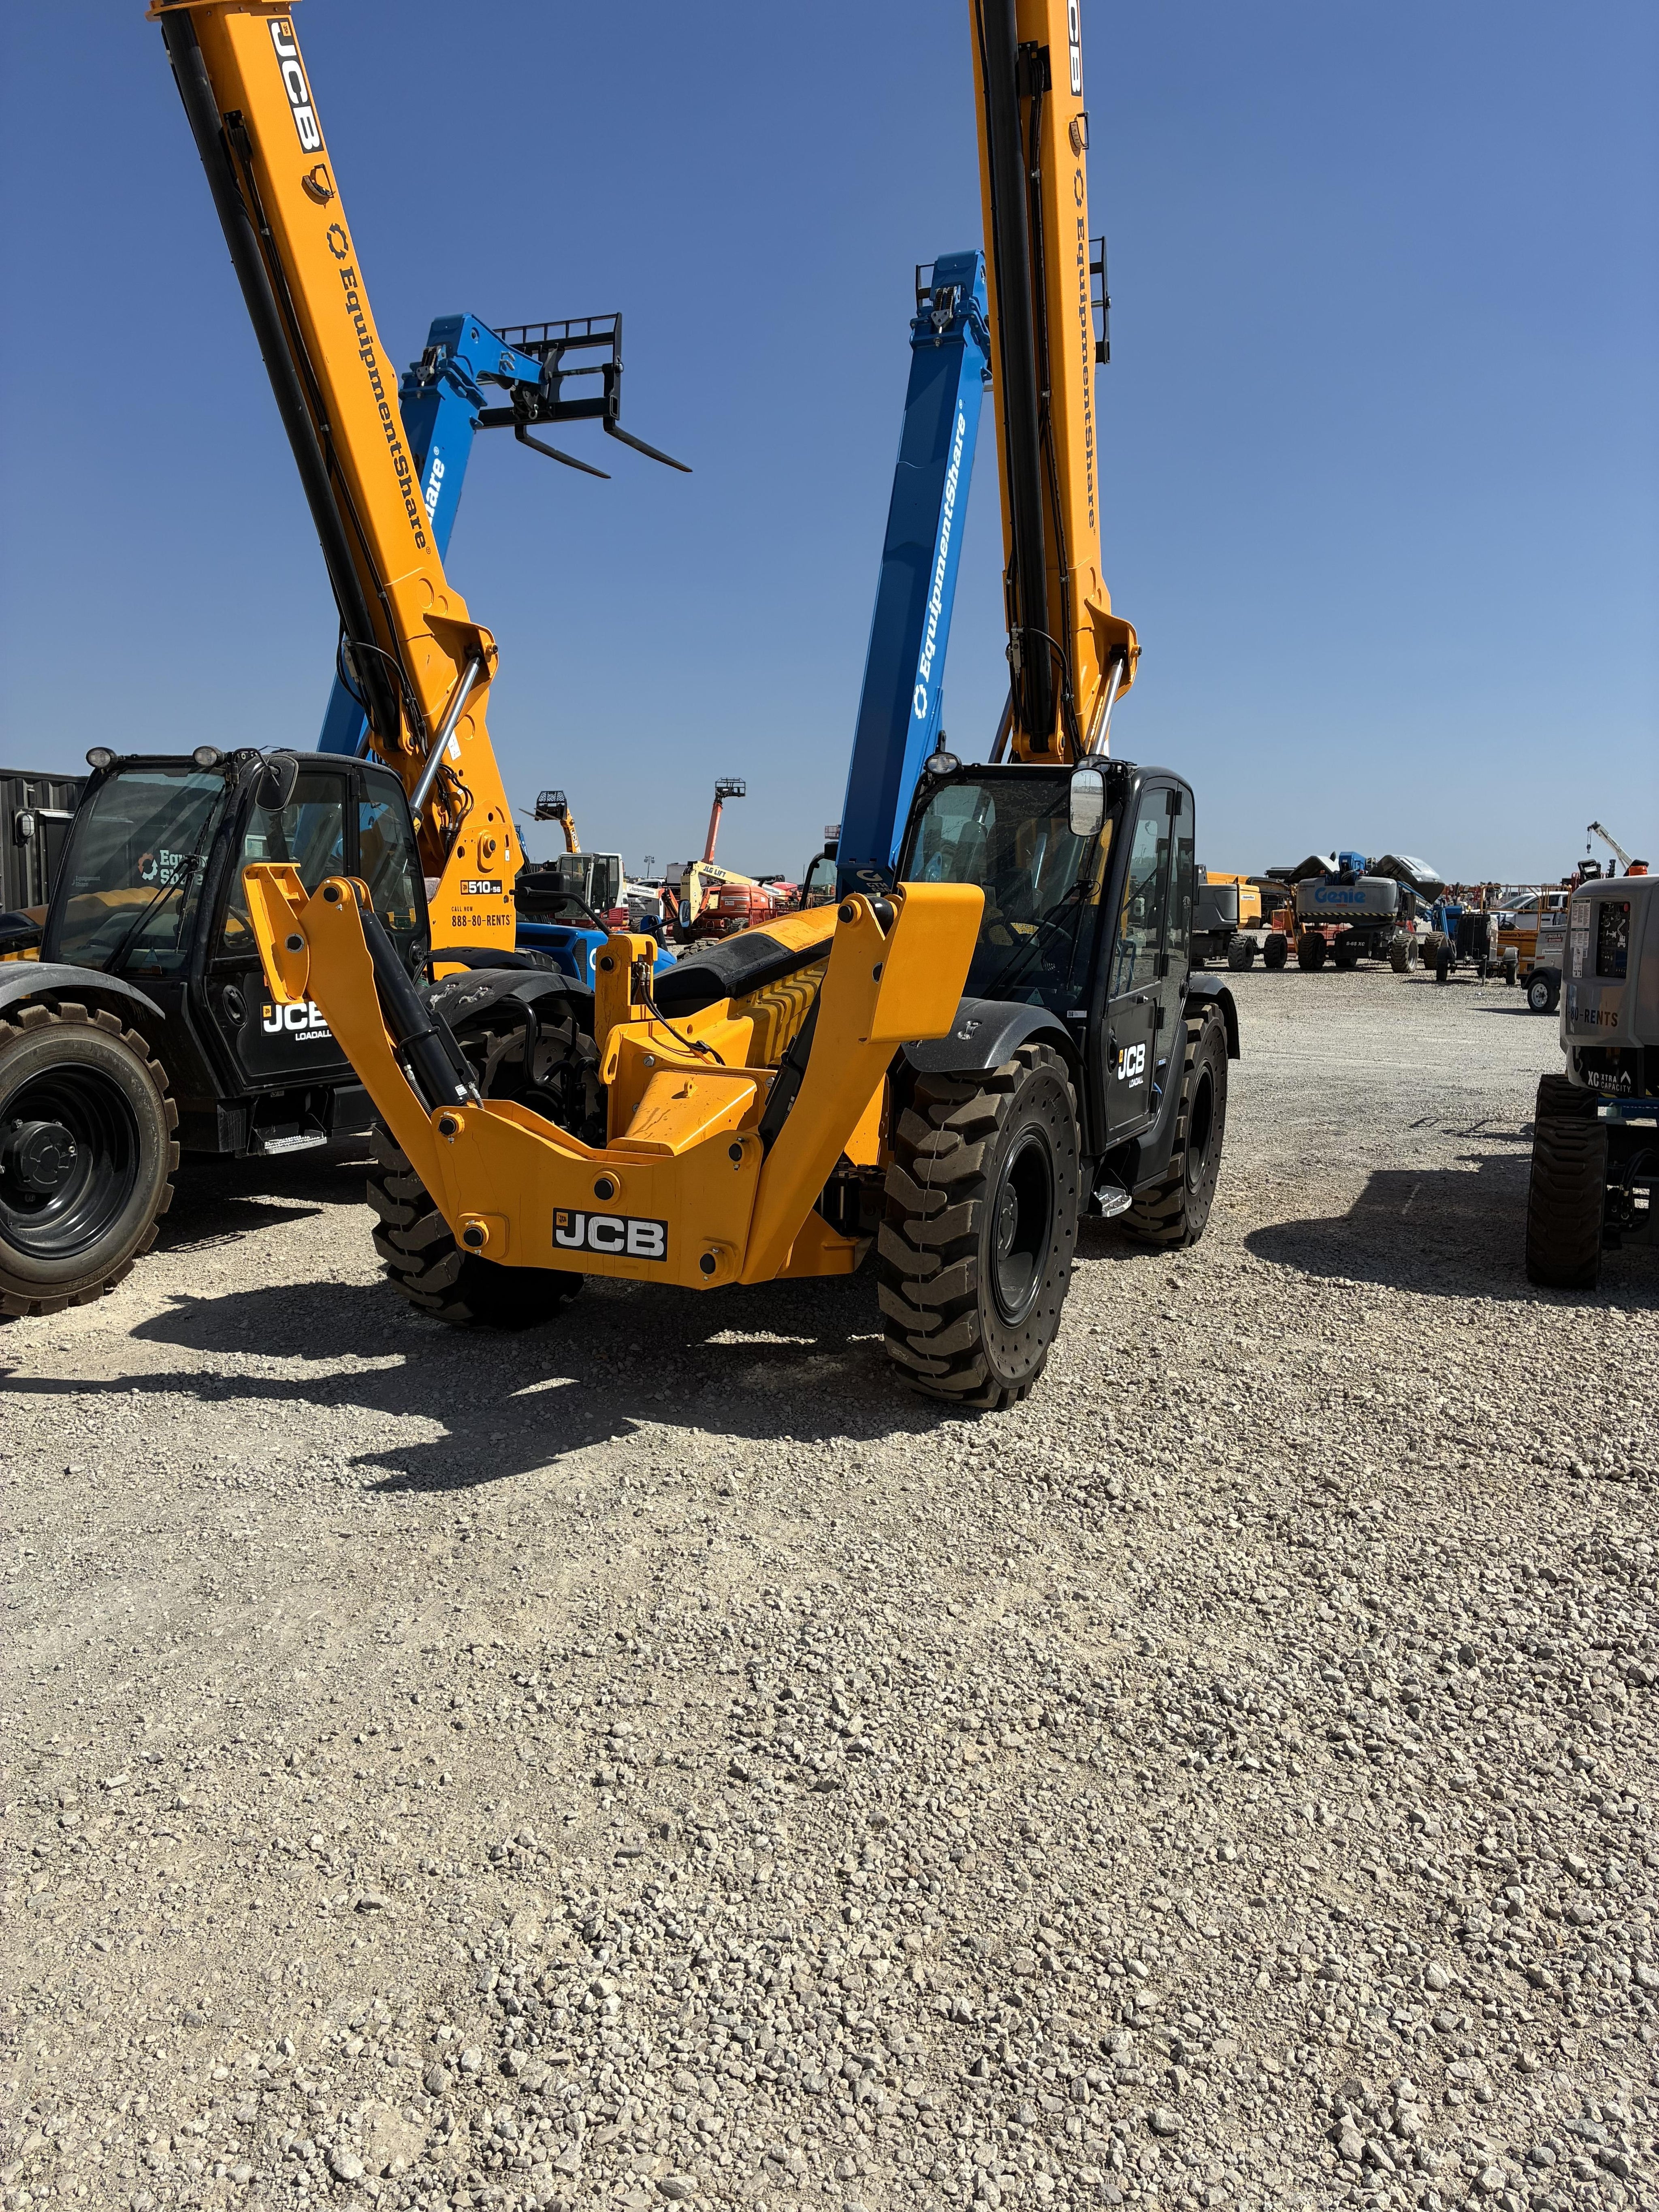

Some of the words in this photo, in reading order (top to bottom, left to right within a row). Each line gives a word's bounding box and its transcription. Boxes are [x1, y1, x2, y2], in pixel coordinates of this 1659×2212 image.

[1067, 0, 1081, 92] CB
[271, 21, 321, 150] JCB
[1076, 216, 1095, 529] EquipmentShare
[339, 266, 426, 550] EquipmentShare
[919, 412, 966, 683] EquipmentShare
[714, 868, 726, 878] LIFT
[1315, 887, 1366, 903] Genie
[452, 915, 510, 927] 888-80-RENTS
[295, 1030, 332, 1041] LOADALL
[1118, 1043, 1145, 1080] JCB
[1588, 1071, 1599, 1087] XC
[1601, 1074, 1617, 1083] XTRA
[1601, 1081, 1631, 1093] CAPACITY
[556, 1214, 664, 1257] JCB
